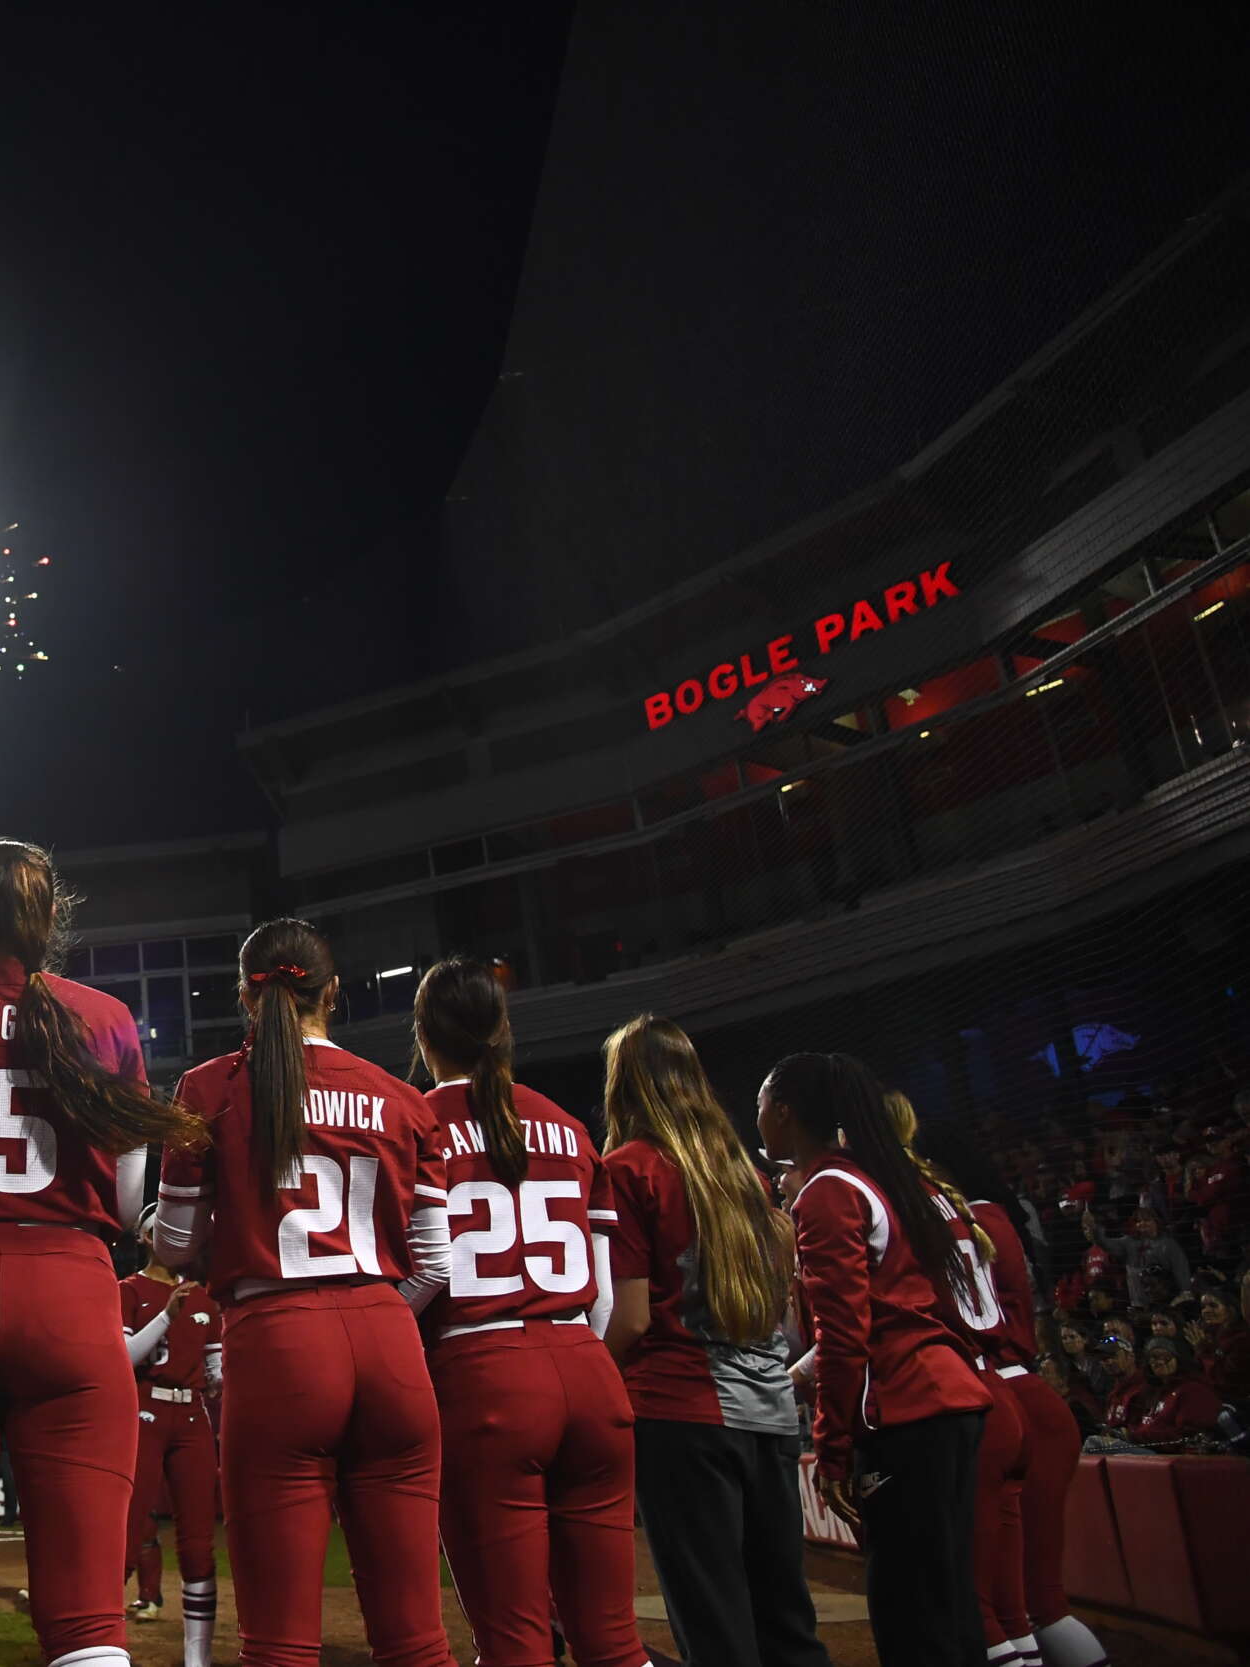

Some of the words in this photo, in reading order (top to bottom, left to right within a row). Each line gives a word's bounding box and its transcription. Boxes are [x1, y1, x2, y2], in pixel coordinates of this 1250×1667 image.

[644, 634, 800, 731] BOGLE
[814, 561, 961, 655] PARK
[276, 1155, 383, 1280] 21
[446, 1180, 591, 1298] 25
